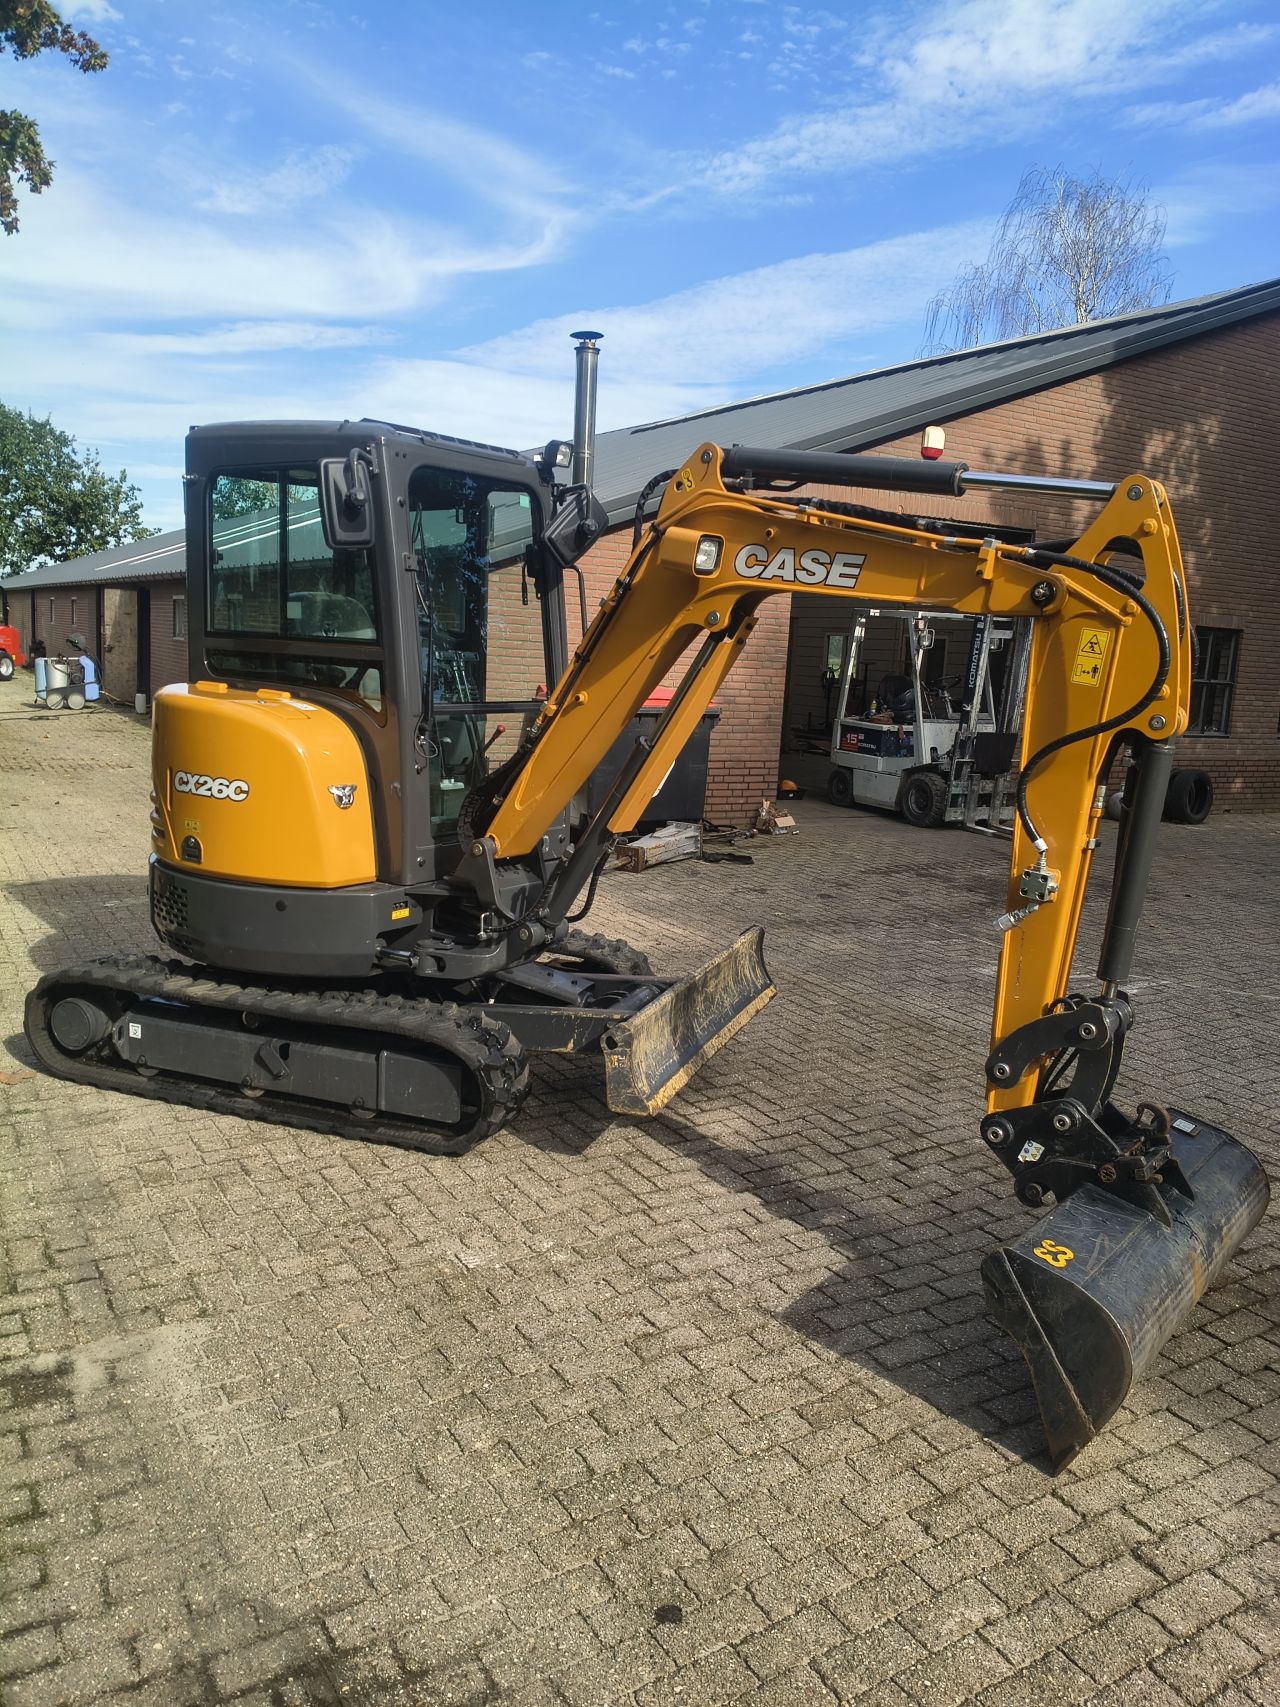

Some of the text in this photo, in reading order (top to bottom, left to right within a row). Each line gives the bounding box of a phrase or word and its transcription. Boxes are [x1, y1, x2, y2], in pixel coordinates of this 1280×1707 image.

[735, 544, 867, 588] CASE
[968, 633, 982, 688] KOMATSU
[846, 733, 858, 744] 15
[174, 770, 250, 802] CX26C
